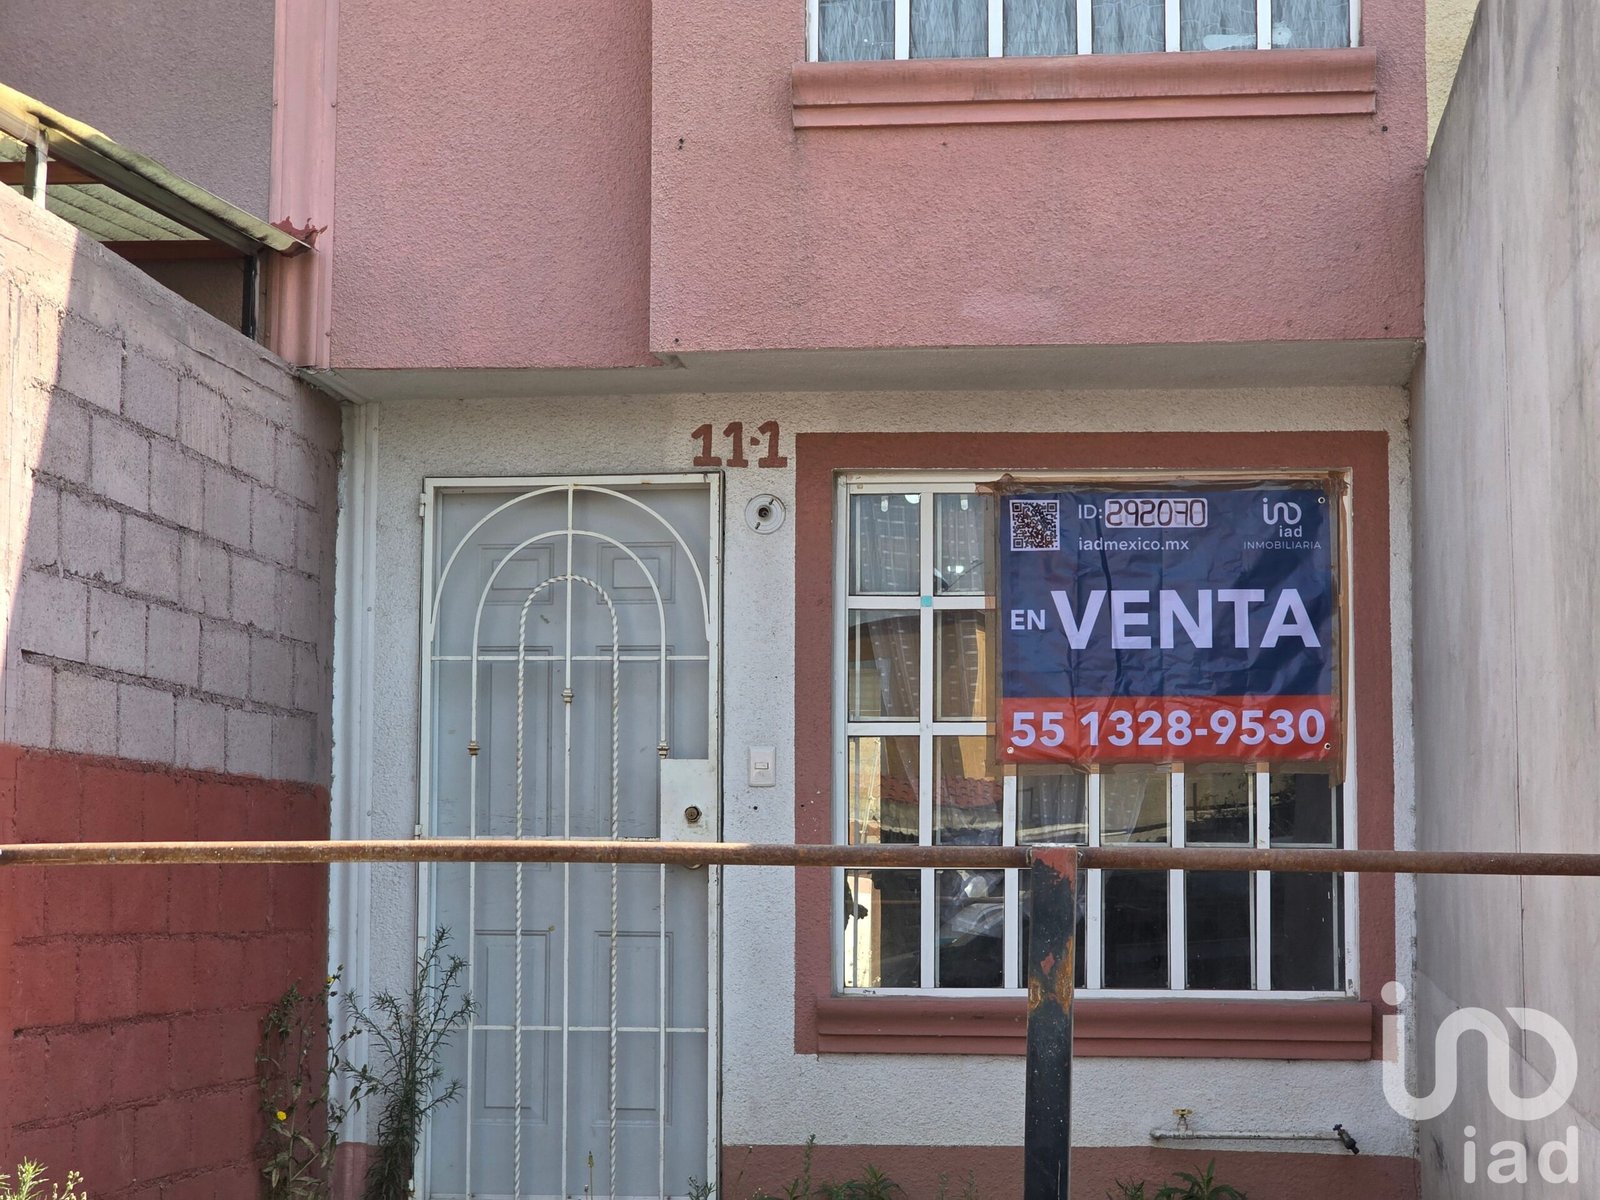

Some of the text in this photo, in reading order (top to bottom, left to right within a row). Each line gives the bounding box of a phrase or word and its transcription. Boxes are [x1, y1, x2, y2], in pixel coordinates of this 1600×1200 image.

[1078, 499, 1206, 527] ID: 292070
[1279, 526, 1303, 538] iad
[1078, 537, 1189, 551] iadmexico.mx
[1243, 541, 1322, 550] INMOBILIARIA
[1010, 588, 1321, 649] EN VENTA
